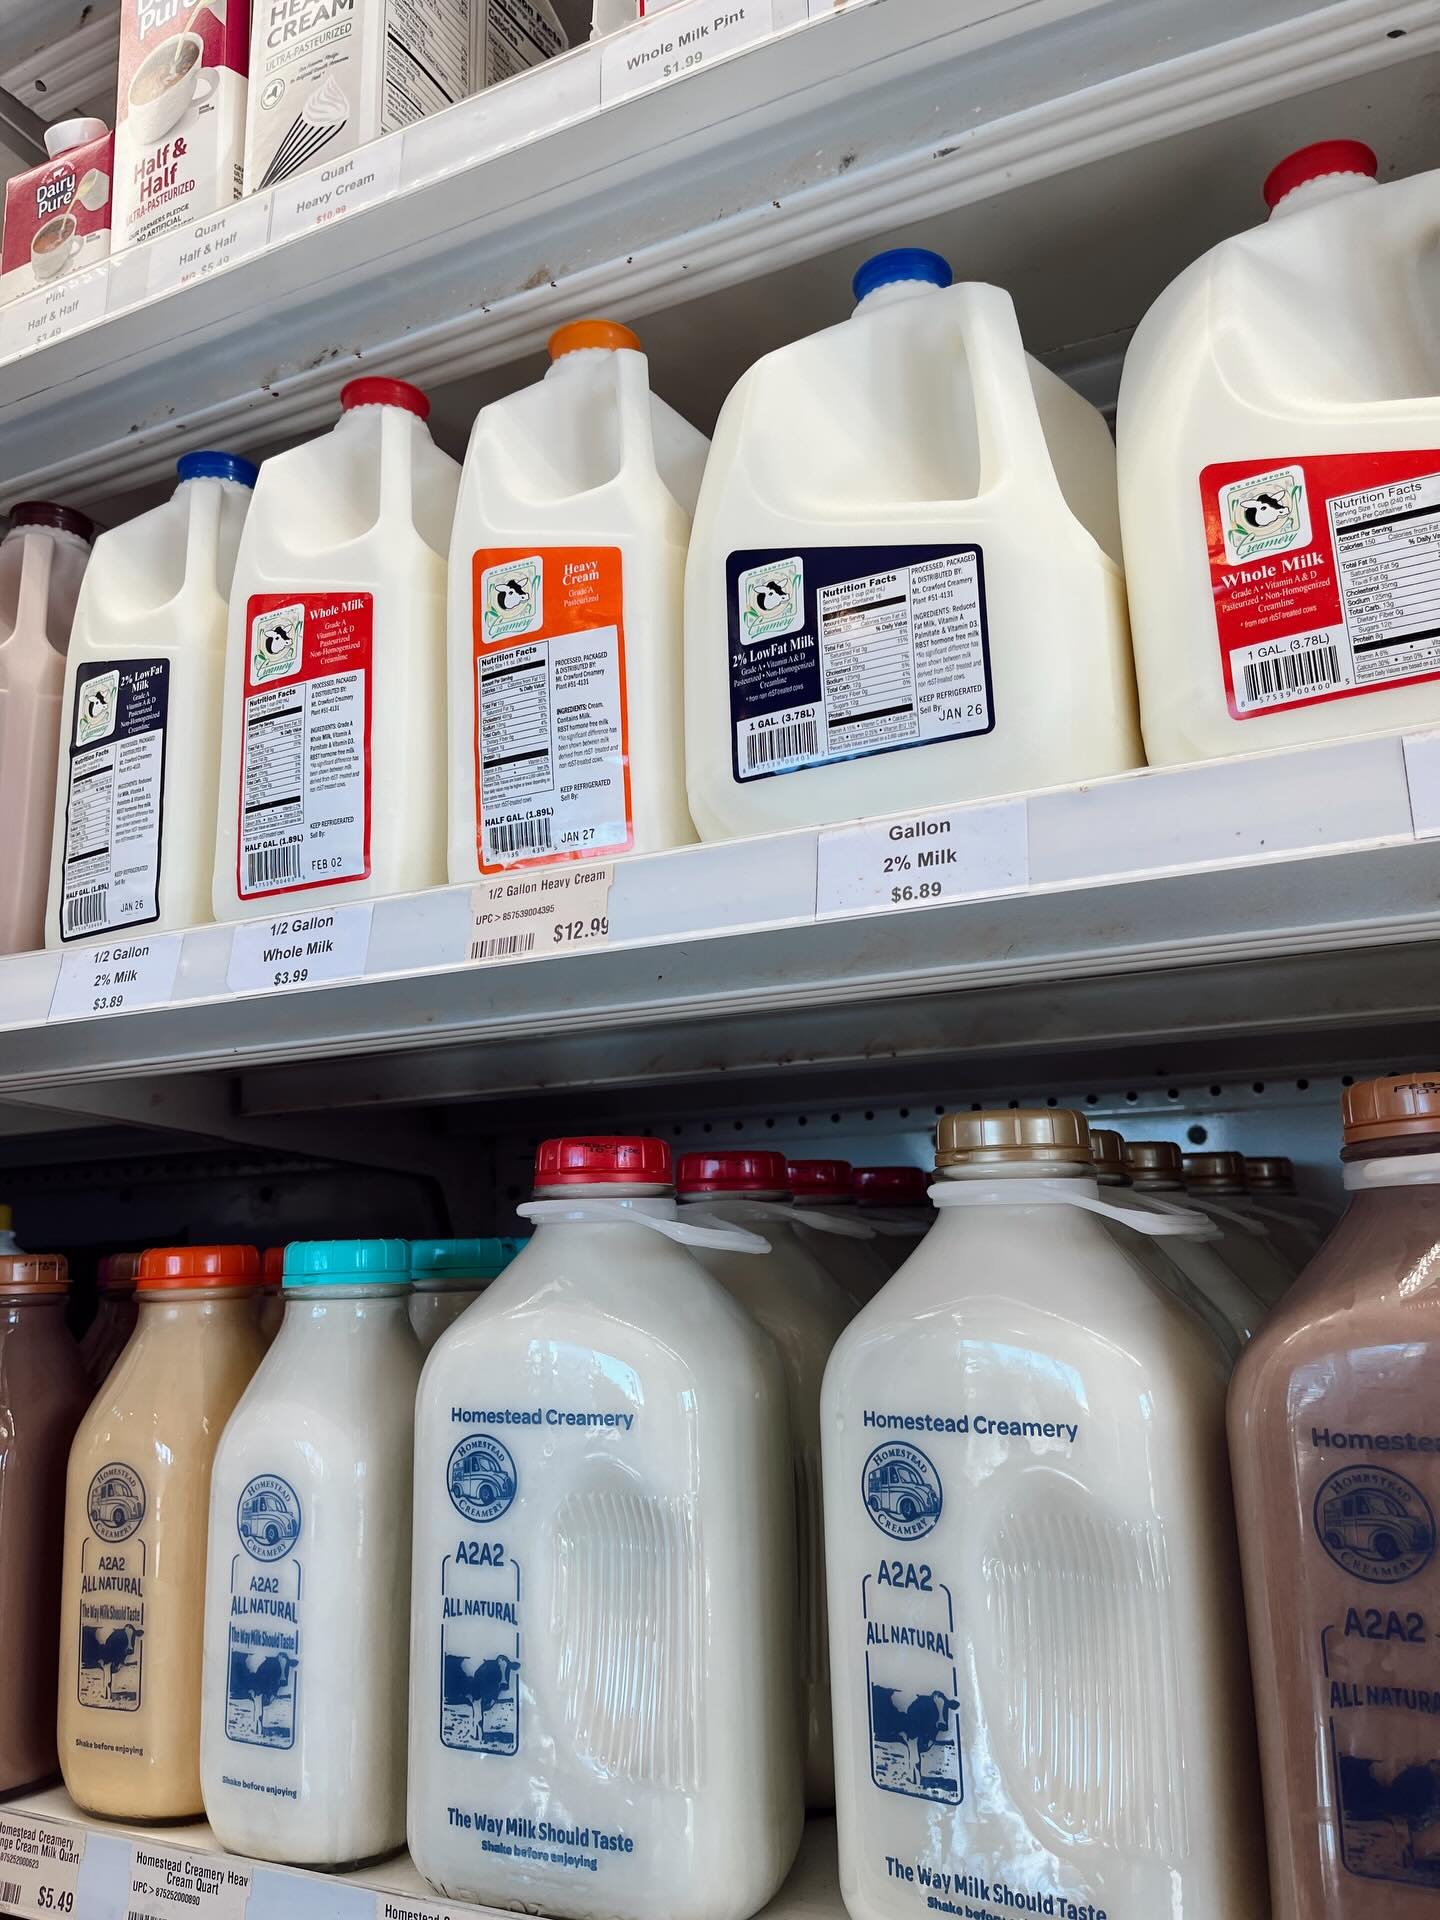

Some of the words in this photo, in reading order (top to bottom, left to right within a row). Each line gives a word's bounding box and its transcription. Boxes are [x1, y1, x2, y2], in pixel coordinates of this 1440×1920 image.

[267, 0, 354, 48] CREAM
[265, 22, 352, 72] ULTRA-PASTEURIZED
[627, 42, 673, 70] Whole
[678, 26, 709, 48] Milk
[714, 8, 745, 30] Pint
[663, 51, 703, 77] $1.99
[134, 143, 169, 184] Half
[173, 137, 187, 158] &
[321, 160, 354, 183] Quart
[36, 174, 76, 204] Dairy
[141, 162, 177, 202] Half
[296, 190, 332, 214] Heavy
[335, 172, 375, 197] Cream
[37, 192, 73, 219] Pure
[194, 219, 226, 239] Quart
[179, 249, 201, 267] Half
[203, 242, 212, 255] &
[215, 231, 238, 250] Half
[59, 299, 80, 318] Half
[1333, 491, 1385, 511] Nutrition
[1388, 482, 1422, 498] Facts
[562, 571, 600, 586] Cream
[564, 560, 599, 576] Heavy
[1221, 566, 1277, 589] Whole
[1282, 551, 1324, 574] Milk
[822, 581, 867, 599] Nutrition
[869, 574, 897, 587] Facts
[1222, 596, 1259, 613] Pasteurized
[1265, 577, 1331, 601] Non-Homogenized
[1231, 589, 1252, 600] Grade
[1253, 584, 1259, 593] A
[1265, 577, 1296, 590] Vitamin
[1295, 574, 1301, 583] A
[1301, 572, 1309, 581] &
[1310, 570, 1317, 579] D
[310, 605, 339, 621] Whole
[341, 598, 364, 612] Milk
[1257, 598, 1295, 613] Creamline
[481, 652, 514, 667] Nutrition
[516, 646, 537, 658] Facts
[732, 652, 748, 668] 2%
[750, 641, 788, 663] LowFat
[790, 634, 815, 652] Milk
[1248, 650, 1253, 661] 1
[1258, 645, 1287, 658] GAL.
[1290, 632, 1330, 653] (3.78L)
[120, 674, 134, 687] 2%
[134, 664, 163, 682] LowFat
[131, 679, 150, 693] Milk
[939, 707, 962, 721] JAN
[967, 703, 983, 717] 26
[484, 816, 505, 828] HALF
[506, 813, 525, 823] GAL.
[526, 807, 554, 821] (1.89L)
[561, 831, 579, 843] JAN
[582, 828, 596, 840] 27
[889, 820, 951, 841] Gallon
[244, 842, 263, 853] HALF
[263, 839, 279, 850] GAL.
[279, 834, 304, 847] (1.89L)
[311, 858, 329, 871] FEB
[331, 856, 342, 868] 02
[883, 854, 911, 873] 2%
[918, 849, 957, 868] Milk
[489, 887, 503, 900] 1/2
[506, 883, 537, 897] Gallon
[541, 877, 571, 891] Heavy
[574, 870, 606, 885] Cream
[891, 881, 942, 904] $6.89
[120, 901, 133, 913] JAN
[135, 899, 144, 911] 26
[270, 921, 288, 937] 1/2
[291, 915, 334, 933] Gallon
[475, 912, 493, 926] UPC
[553, 916, 609, 944] $12.99
[93, 951, 110, 964] 1/2
[112, 945, 149, 962] Gallon
[263, 946, 303, 963] Whole
[306, 939, 334, 955] Milk
[93, 973, 111, 987] 2%
[113, 969, 138, 984] Milk
[273, 968, 309, 986] $3.99
[92, 995, 124, 1012] $3.89
[451, 1406, 543, 1425] Homestead
[545, 1408, 635, 1431] Creamery
[863, 1410, 969, 1434] Homestead
[973, 1415, 1079, 1443] Creamery
[457, 1439, 506, 1463] HOMESTEAD
[1311, 1427, 1440, 1452] Homeste
[872, 1447, 928, 1475] HOMESTEAD
[97, 1468, 137, 1488] HOMESTEAD
[247, 1479, 292, 1503] HOMESTEAD
[458, 1498, 505, 1518] CREAMERY
[95, 1521, 133, 1539] CREAMERY
[877, 1512, 930, 1536] CREAMERY
[246, 1538, 288, 1558] CREAMERY
[455, 1541, 505, 1567] A2A2
[98, 1556, 126, 1571] A2A2
[877, 1559, 934, 1592] A2A2
[81, 1575, 98, 1594] ALL
[98, 1576, 144, 1598] NATURAL
[250, 1575, 279, 1594] A2A2
[231, 1595, 249, 1617] ALL
[250, 1597, 298, 1624] NATURAL
[442, 1597, 463, 1619] ALL
[464, 1600, 519, 1626] NATURAL
[1344, 1607, 1427, 1643] A2A2
[866, 1621, 889, 1646] ALL
[891, 1625, 955, 1660] NATURAL
[1330, 1681, 1364, 1709] ALL
[1365, 1685, 1440, 1714] NATURA
[222, 1775, 241, 1788] Shake
[242, 1779, 265, 1792] before
[266, 1785, 297, 1800] enjoying
[38, 1830, 74, 1852] Creamery
[447, 1807, 471, 1829] The
[474, 1812, 504, 1837] Way
[505, 1817, 537, 1840] Milk
[538, 1822, 590, 1848] Should
[592, 1830, 634, 1853] Taste
[15, 1838, 39, 1856] Cream
[41, 1843, 57, 1860] Milk
[59, 1848, 80, 1865] Quart
[481, 1839, 513, 1857] Shake
[513, 1844, 550, 1861] before
[550, 1852, 598, 1872] enjoying
[136, 1850, 182, 1873] Homestead
[185, 1861, 225, 1885] Creamery
[132, 1880, 148, 1894] UPC
[166, 1871, 193, 1890] Cream
[196, 1877, 219, 1896] Quart
[885, 1856, 914, 1882] The
[916, 1864, 951, 1894] Way
[954, 1873, 990, 1902] Milk
[993, 1882, 1054, 1916] Should
[1056, 1896, 1108, 1920] Taste
[37, 1885, 74, 1914] $5.49
[927, 1895, 963, 1916] Shake
